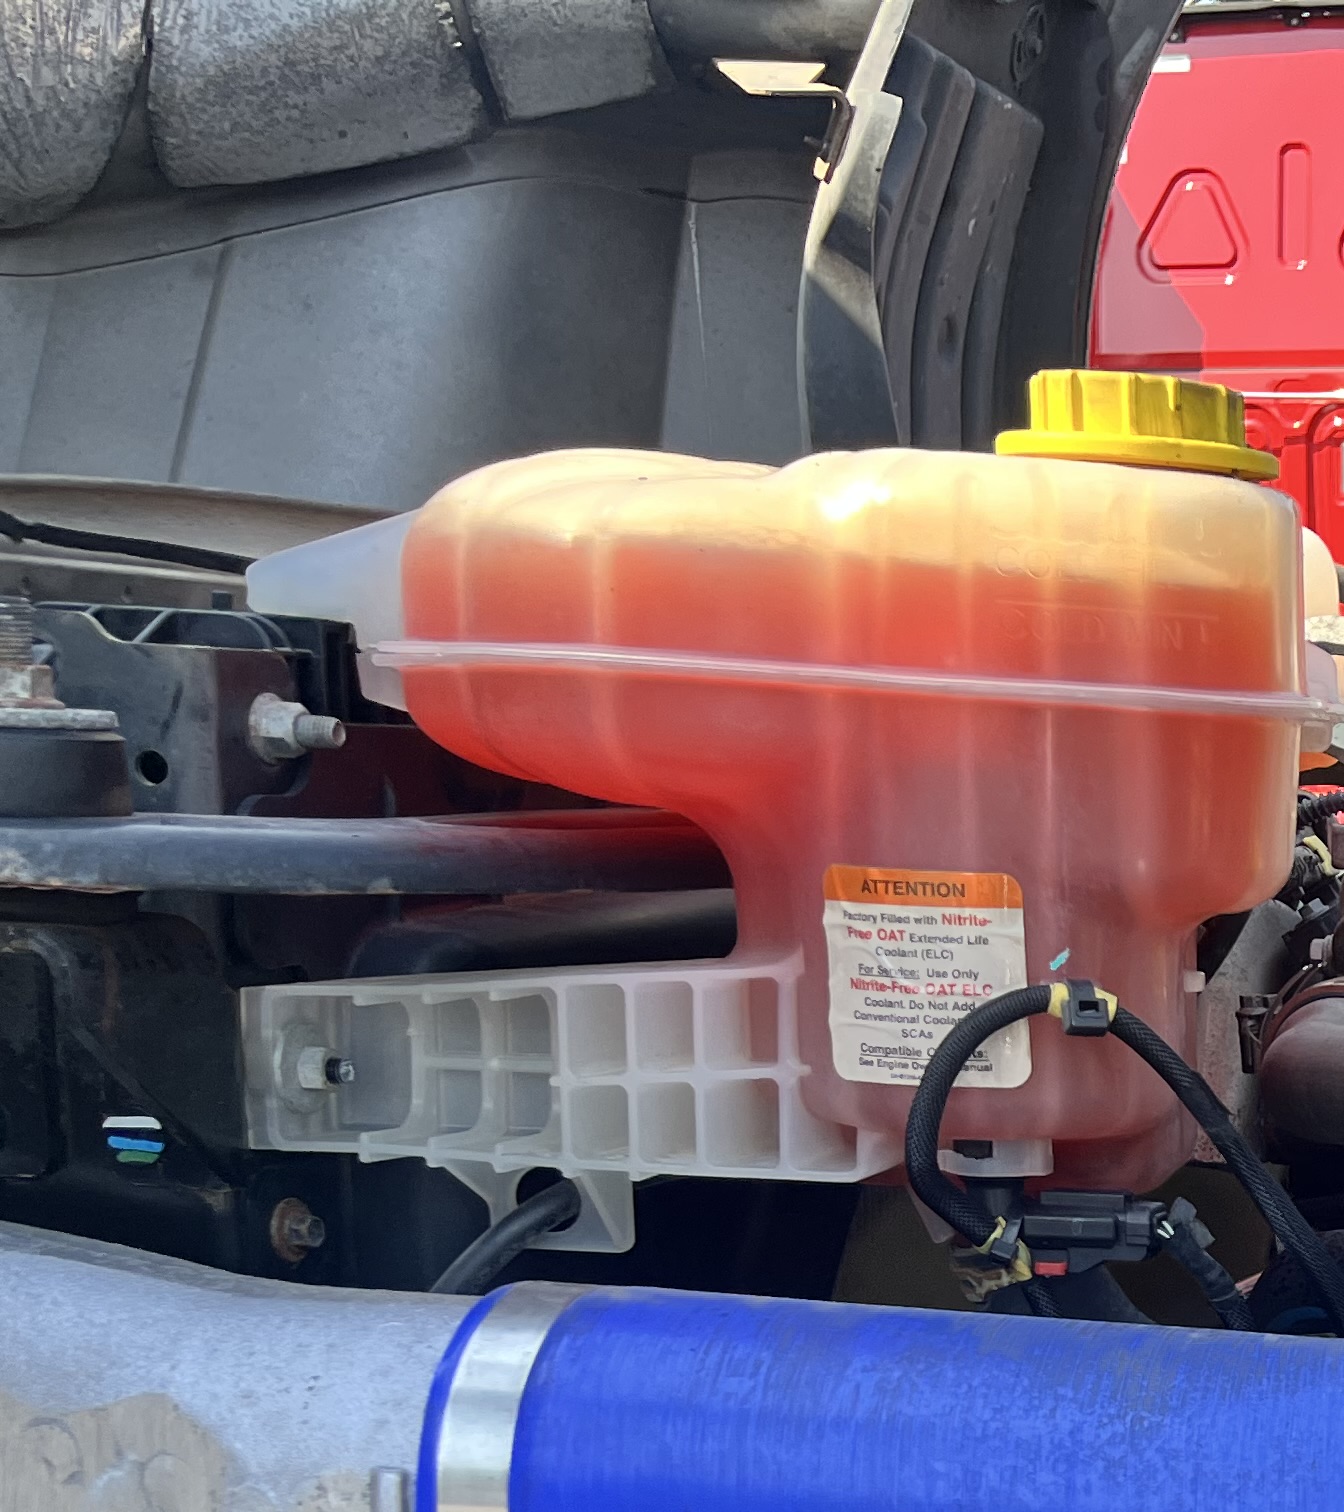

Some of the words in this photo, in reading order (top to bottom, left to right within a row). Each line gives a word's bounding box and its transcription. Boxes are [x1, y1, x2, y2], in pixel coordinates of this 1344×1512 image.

[861, 879, 966, 898] ATTENTION
[843, 911, 877, 924] Factory
[880, 913, 910, 925] Filled
[913, 914, 937, 925] with
[941, 913, 993, 926] Nitrite-
[847, 926, 873, 940] Free
[877, 928, 906, 942] OAT
[909, 932, 963, 945] Extended
[967, 934, 989, 945] Life
[875, 947, 918, 959] Coolant
[921, 949, 954, 961] (ELC)
[858, 963, 875, 976] For
[877, 964, 920, 979] Service:
[926, 969, 947, 979] Use
[951, 969, 980, 981] Only
[850, 977, 920, 995] Nitrite-Free
[925, 983, 956, 996] OAT
[962, 984, 994, 997] ELC
[909, 998, 924, 1010] Do
[928, 999, 948, 1011] Not
[952, 1000, 976, 1012] Add
[854, 1010, 920, 1024] Conventional
[901, 1028, 934, 1039] SCAs
[861, 1043, 922, 1058] Compatible
[859, 1056, 874, 1067] See
[877, 1058, 909, 1071] Engine
